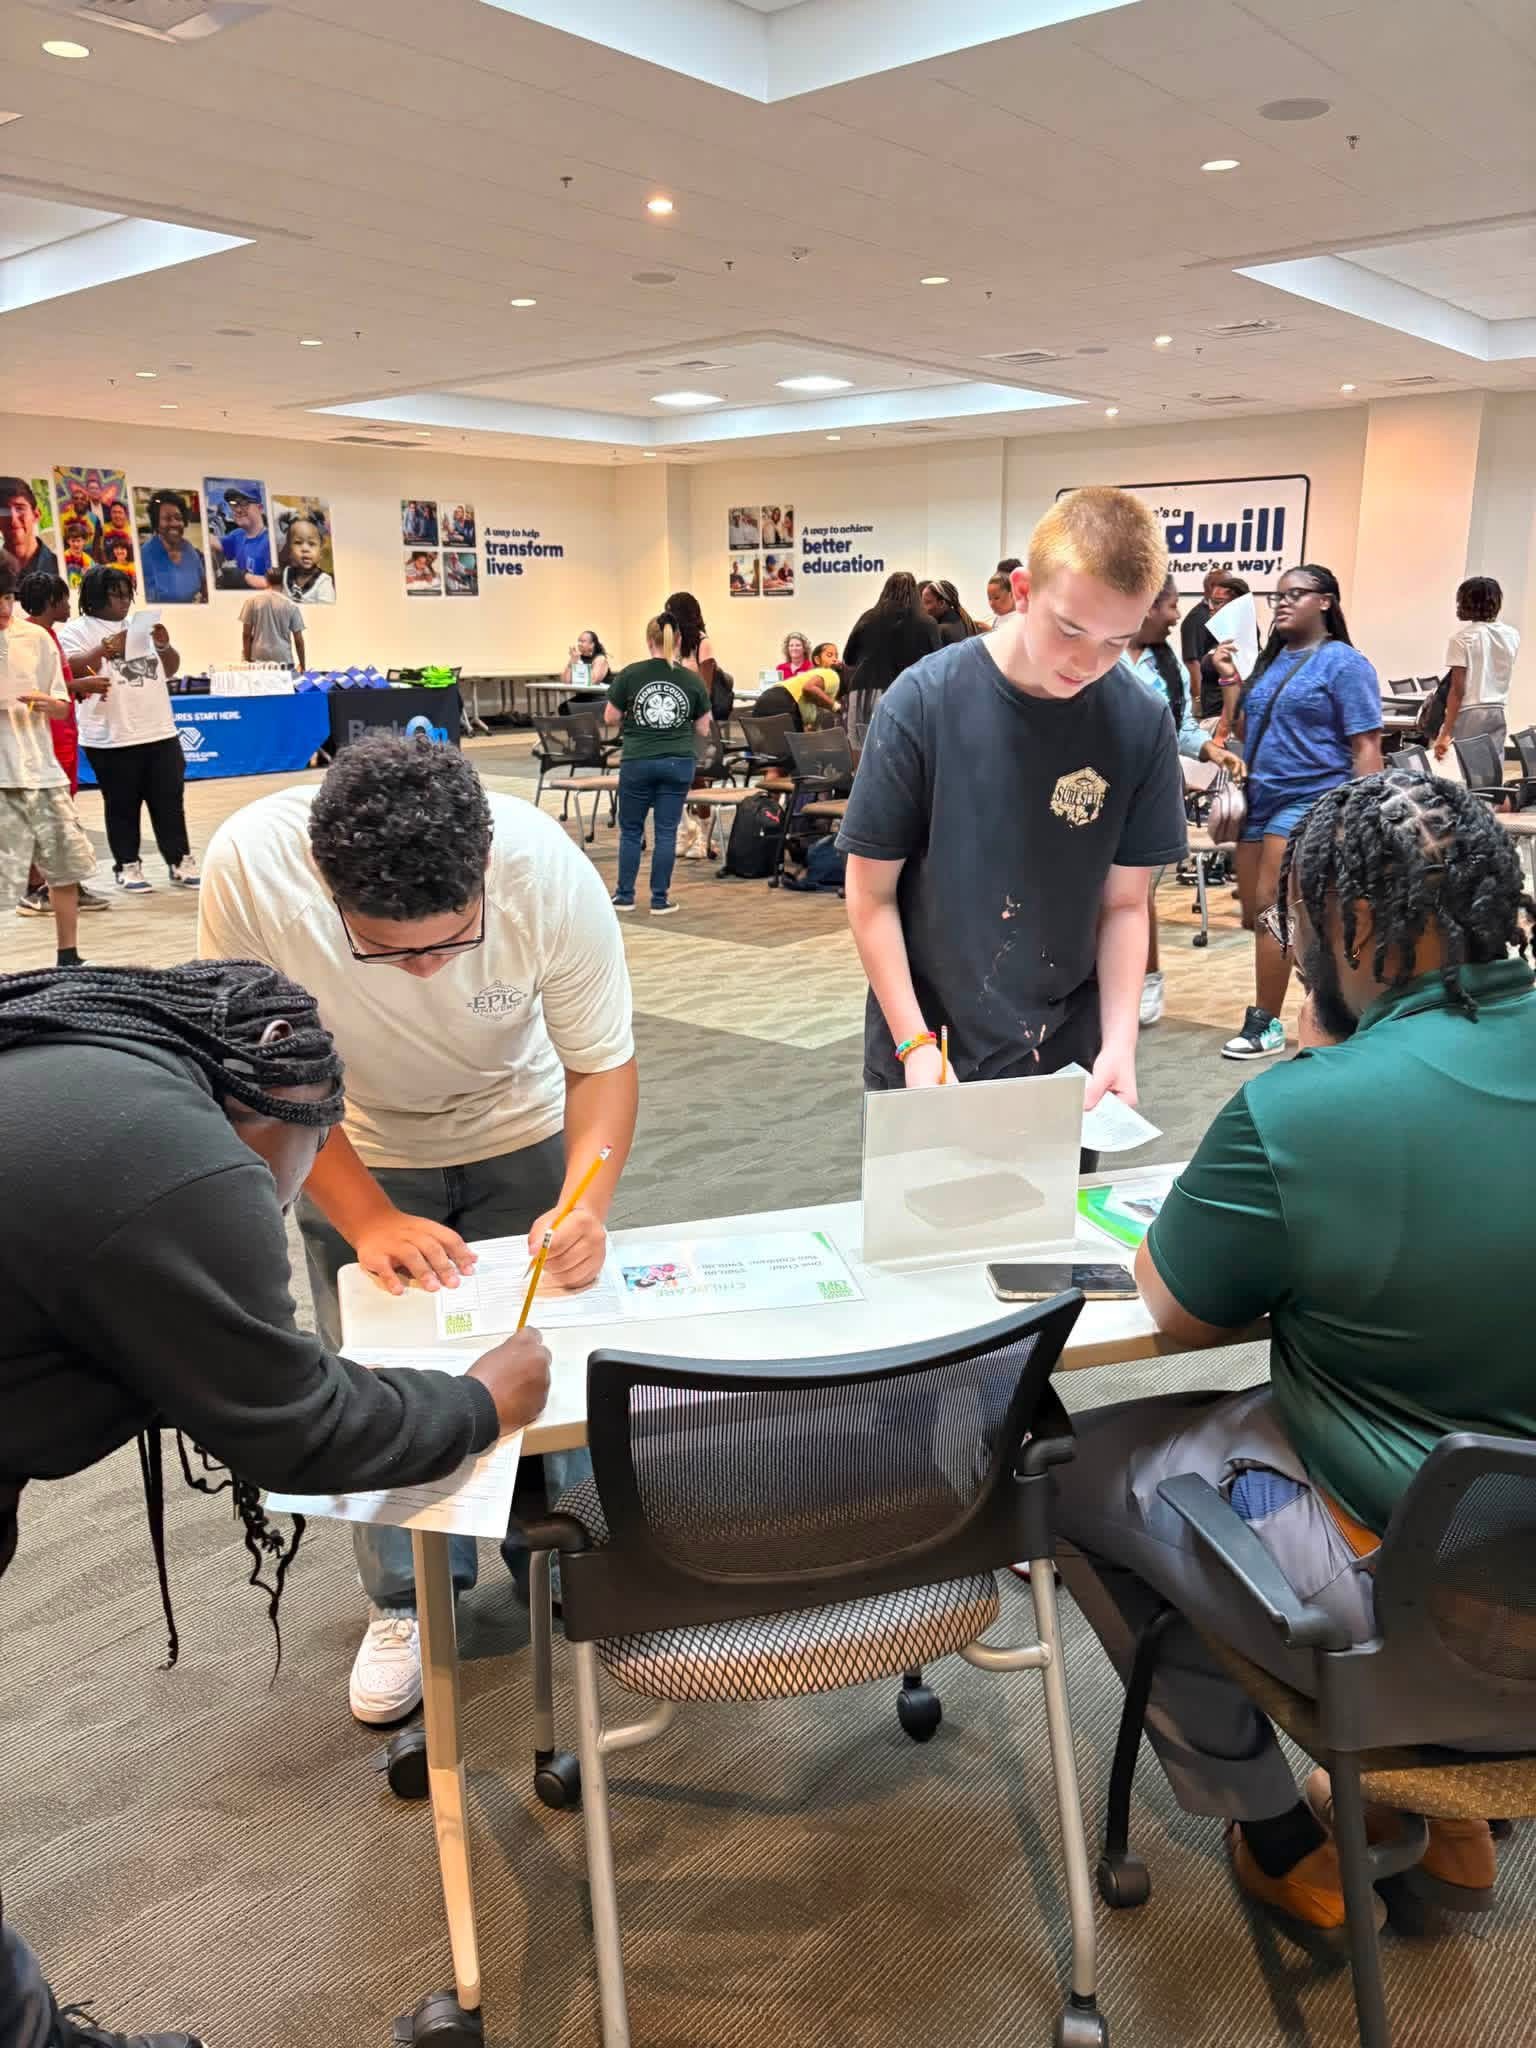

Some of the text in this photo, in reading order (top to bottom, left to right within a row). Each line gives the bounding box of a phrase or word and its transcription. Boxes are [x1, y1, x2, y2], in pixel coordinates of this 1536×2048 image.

[1172, 509, 1182, 518] a
[485, 528, 540, 539] A way to help
[802, 524, 874, 536] A way to achieve
[485, 540, 564, 557] transform
[802, 538, 852, 554] better
[486, 557, 523, 575] lives
[802, 554, 885, 573] education
[1167, 559, 1220, 572] there's
[1222, 560, 1233, 571] a
[638, 684, 688, 711] MOBILE COUNTY
[195, 711, 218, 720] START
[473, 991, 523, 1009] EPIC
